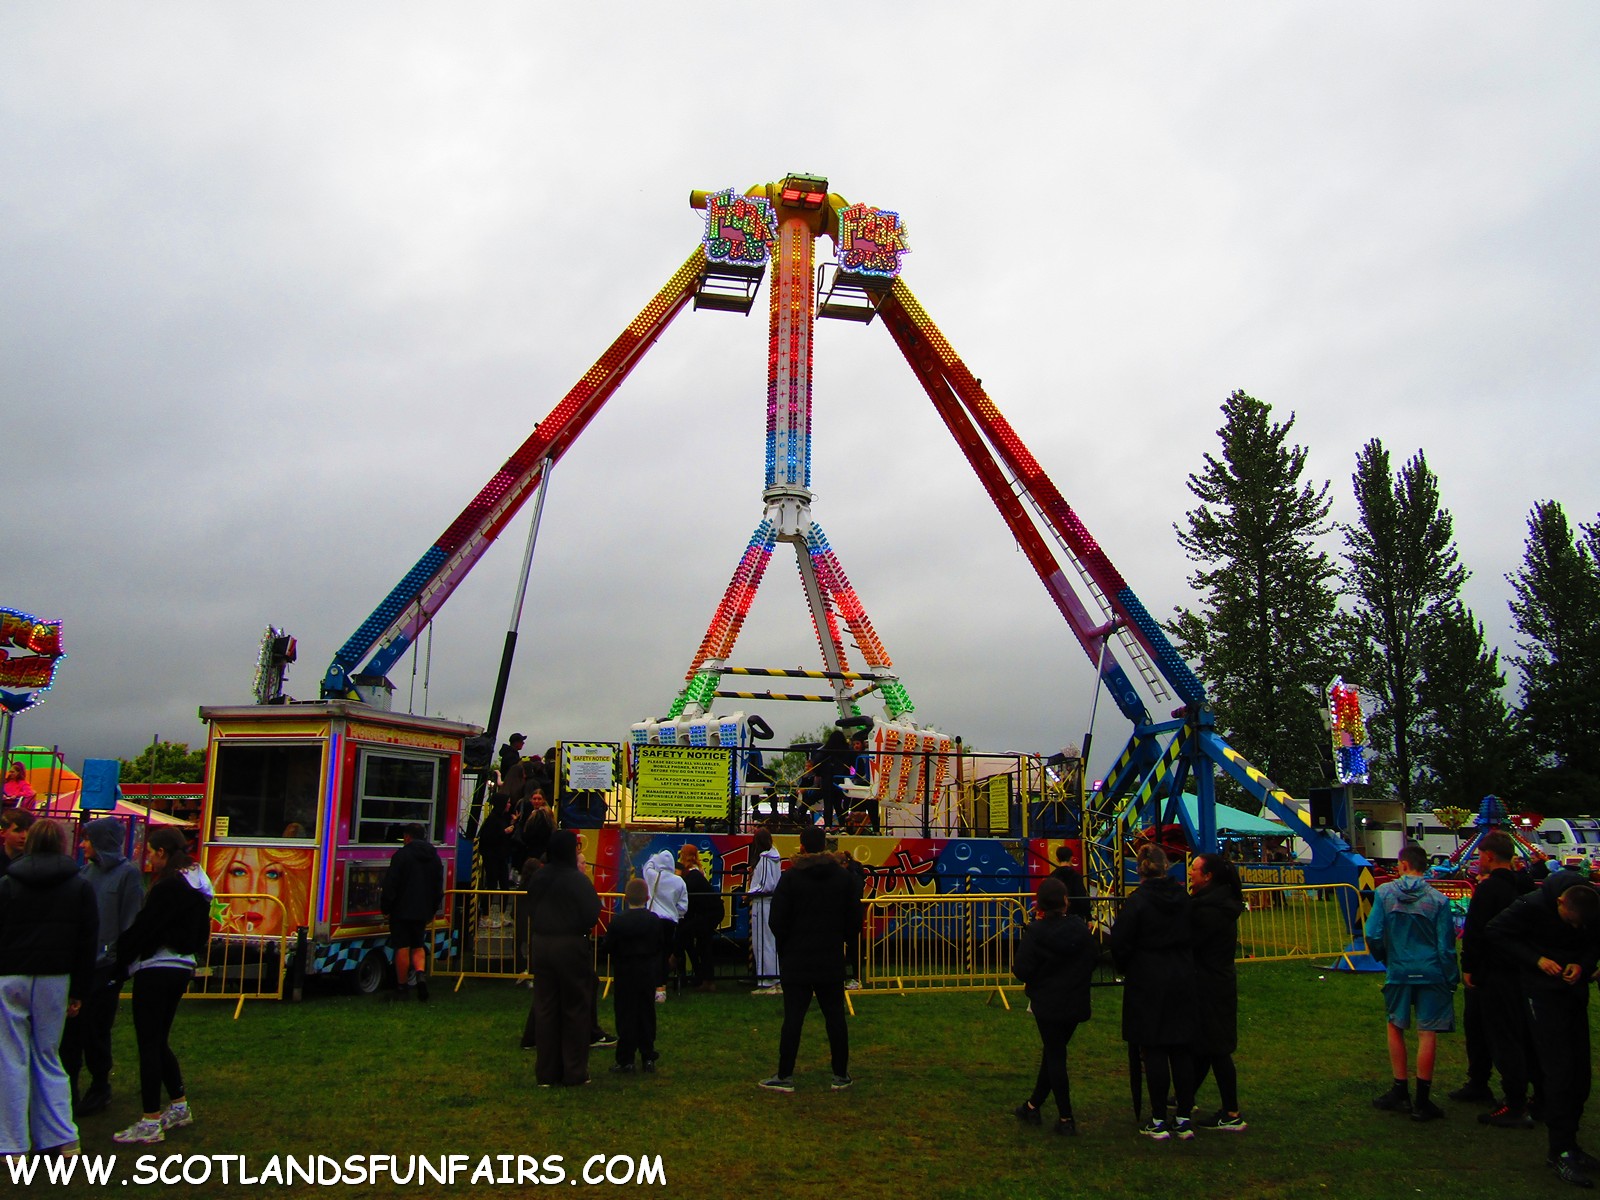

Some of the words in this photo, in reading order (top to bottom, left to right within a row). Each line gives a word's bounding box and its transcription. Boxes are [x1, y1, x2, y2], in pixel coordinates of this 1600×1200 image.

[708, 194, 775, 241] Freak
[842, 208, 905, 252] Freak
[642, 750, 683, 758] SAFETY
[687, 752, 726, 760] NOTICE
[1238, 866, 1279, 883] Pleasure
[1280, 866, 1305, 884] Fairs
